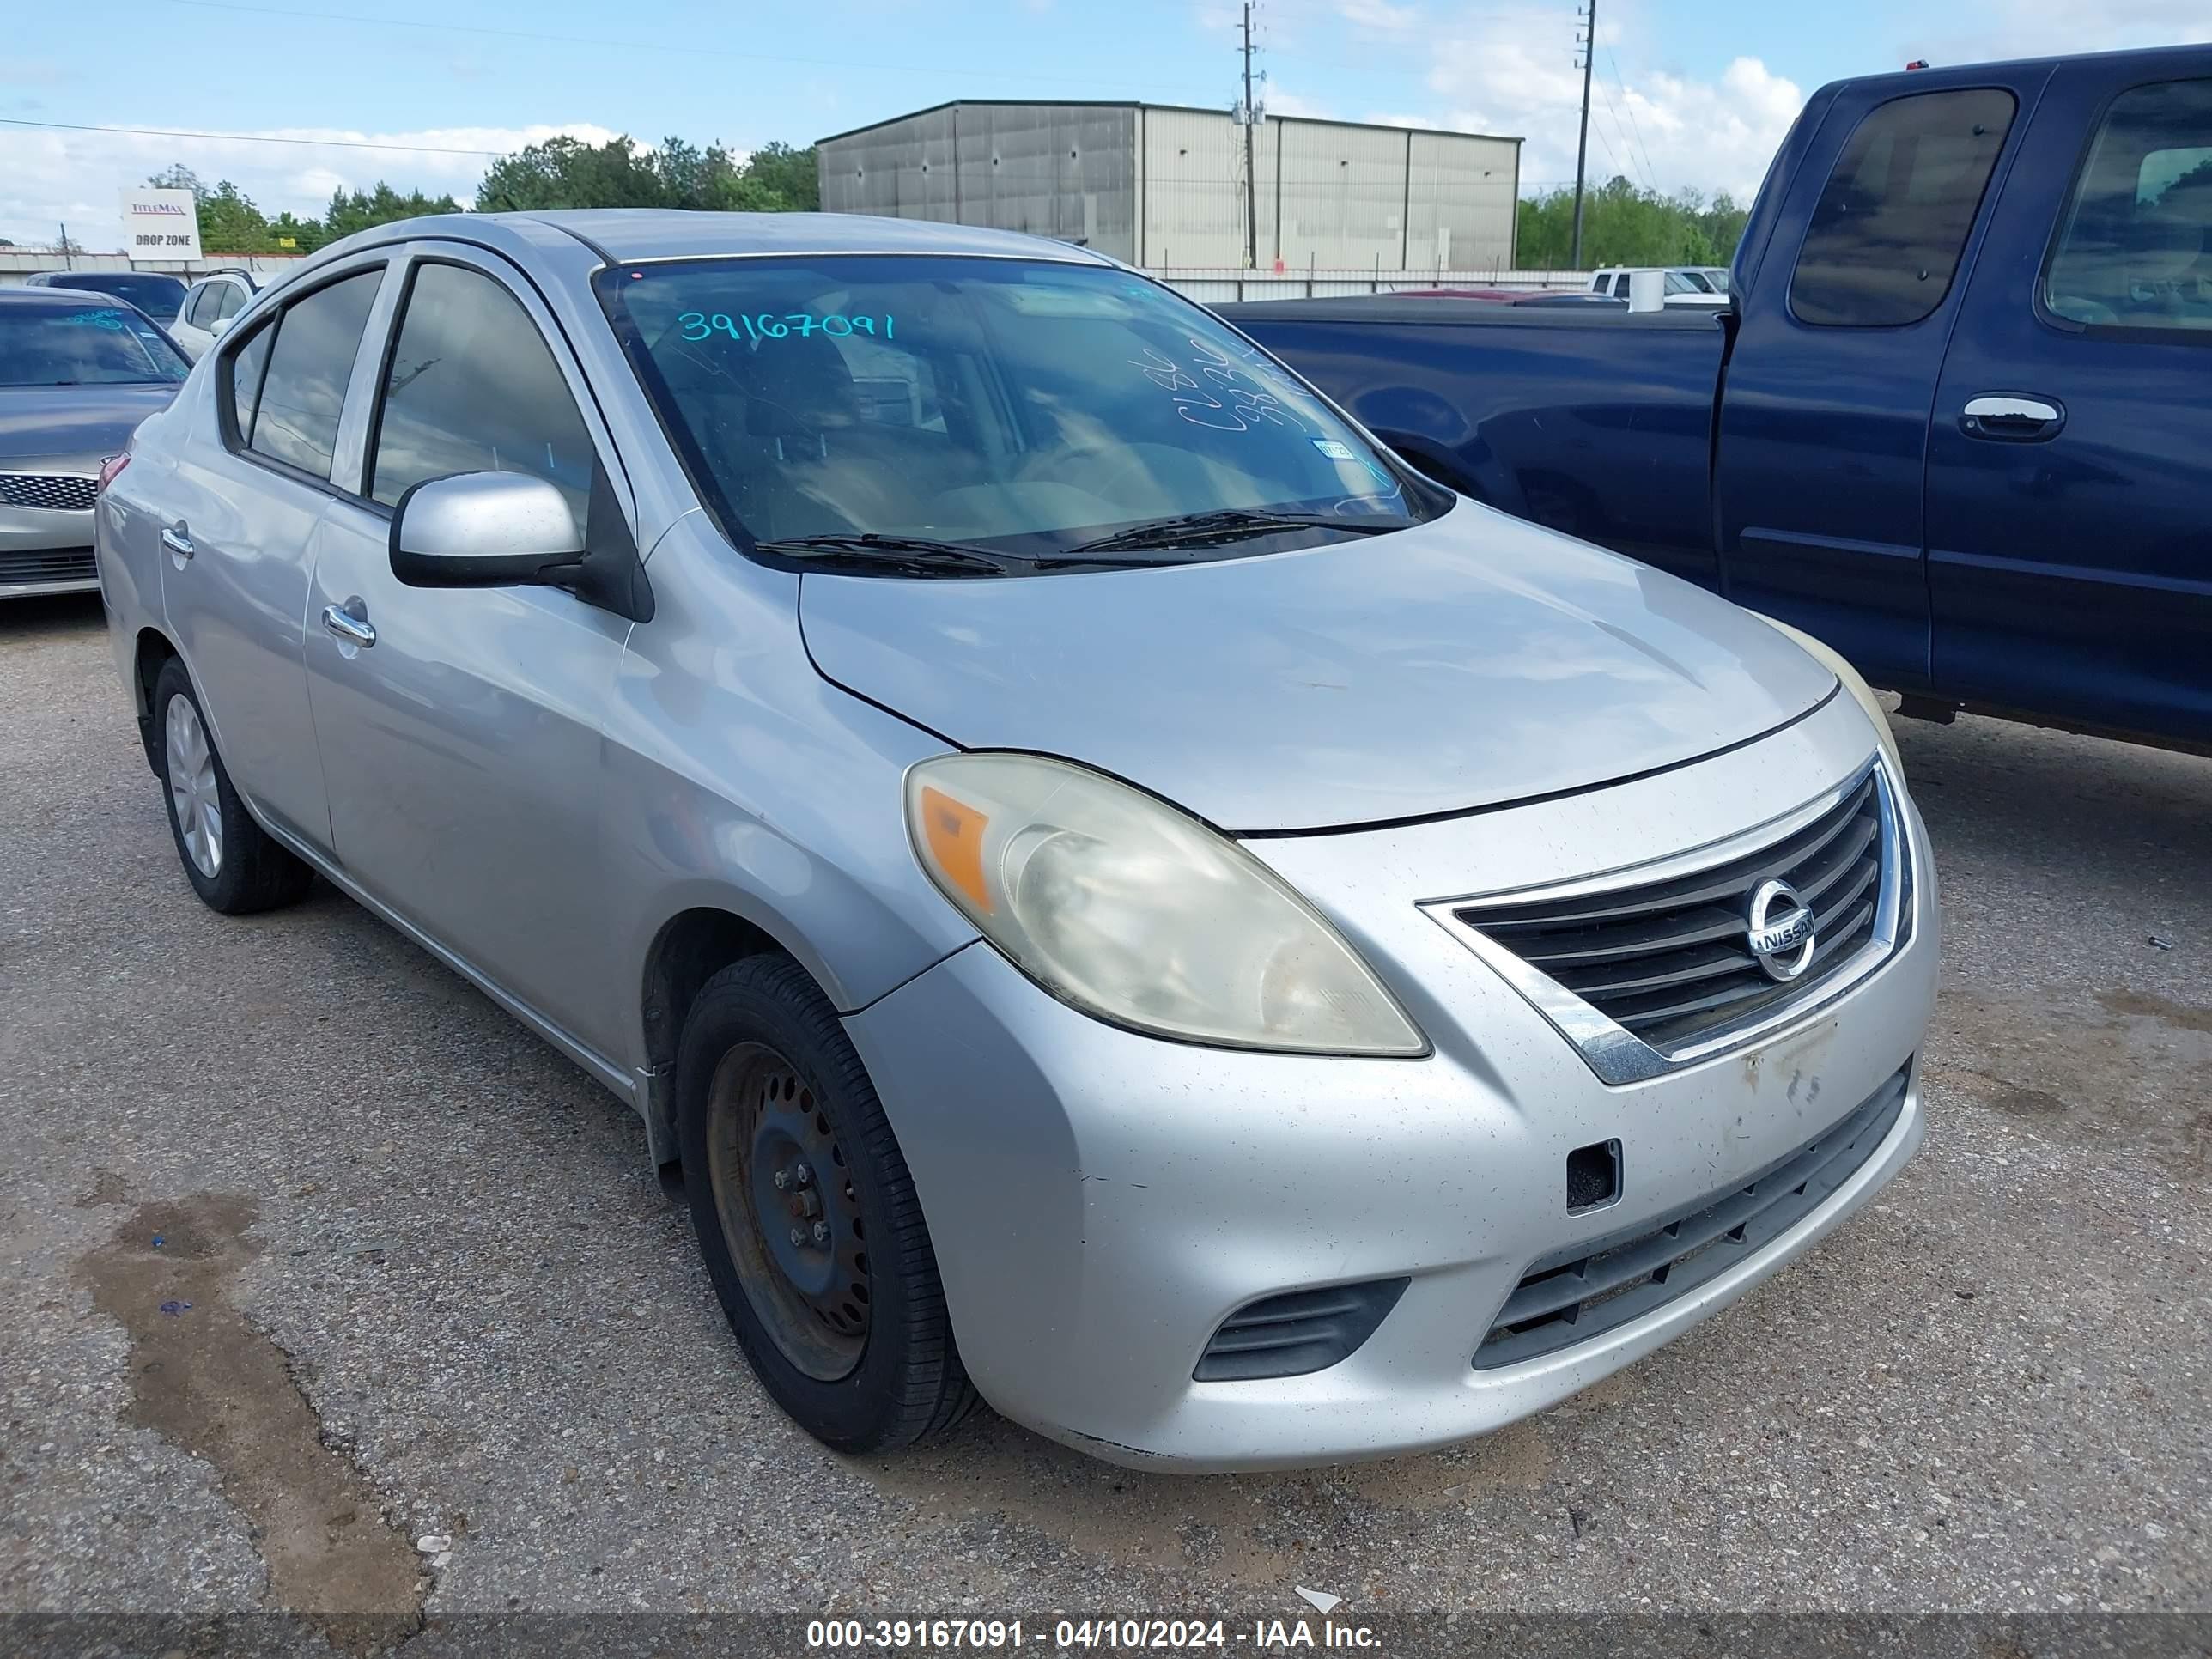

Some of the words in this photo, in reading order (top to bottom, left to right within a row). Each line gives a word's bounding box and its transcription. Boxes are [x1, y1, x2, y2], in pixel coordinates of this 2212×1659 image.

[136, 234, 163, 246] DROP
[166, 235, 191, 246] ZONE
[678, 312, 894, 340] 39167091
[1764, 918, 1812, 951] NISSAN
